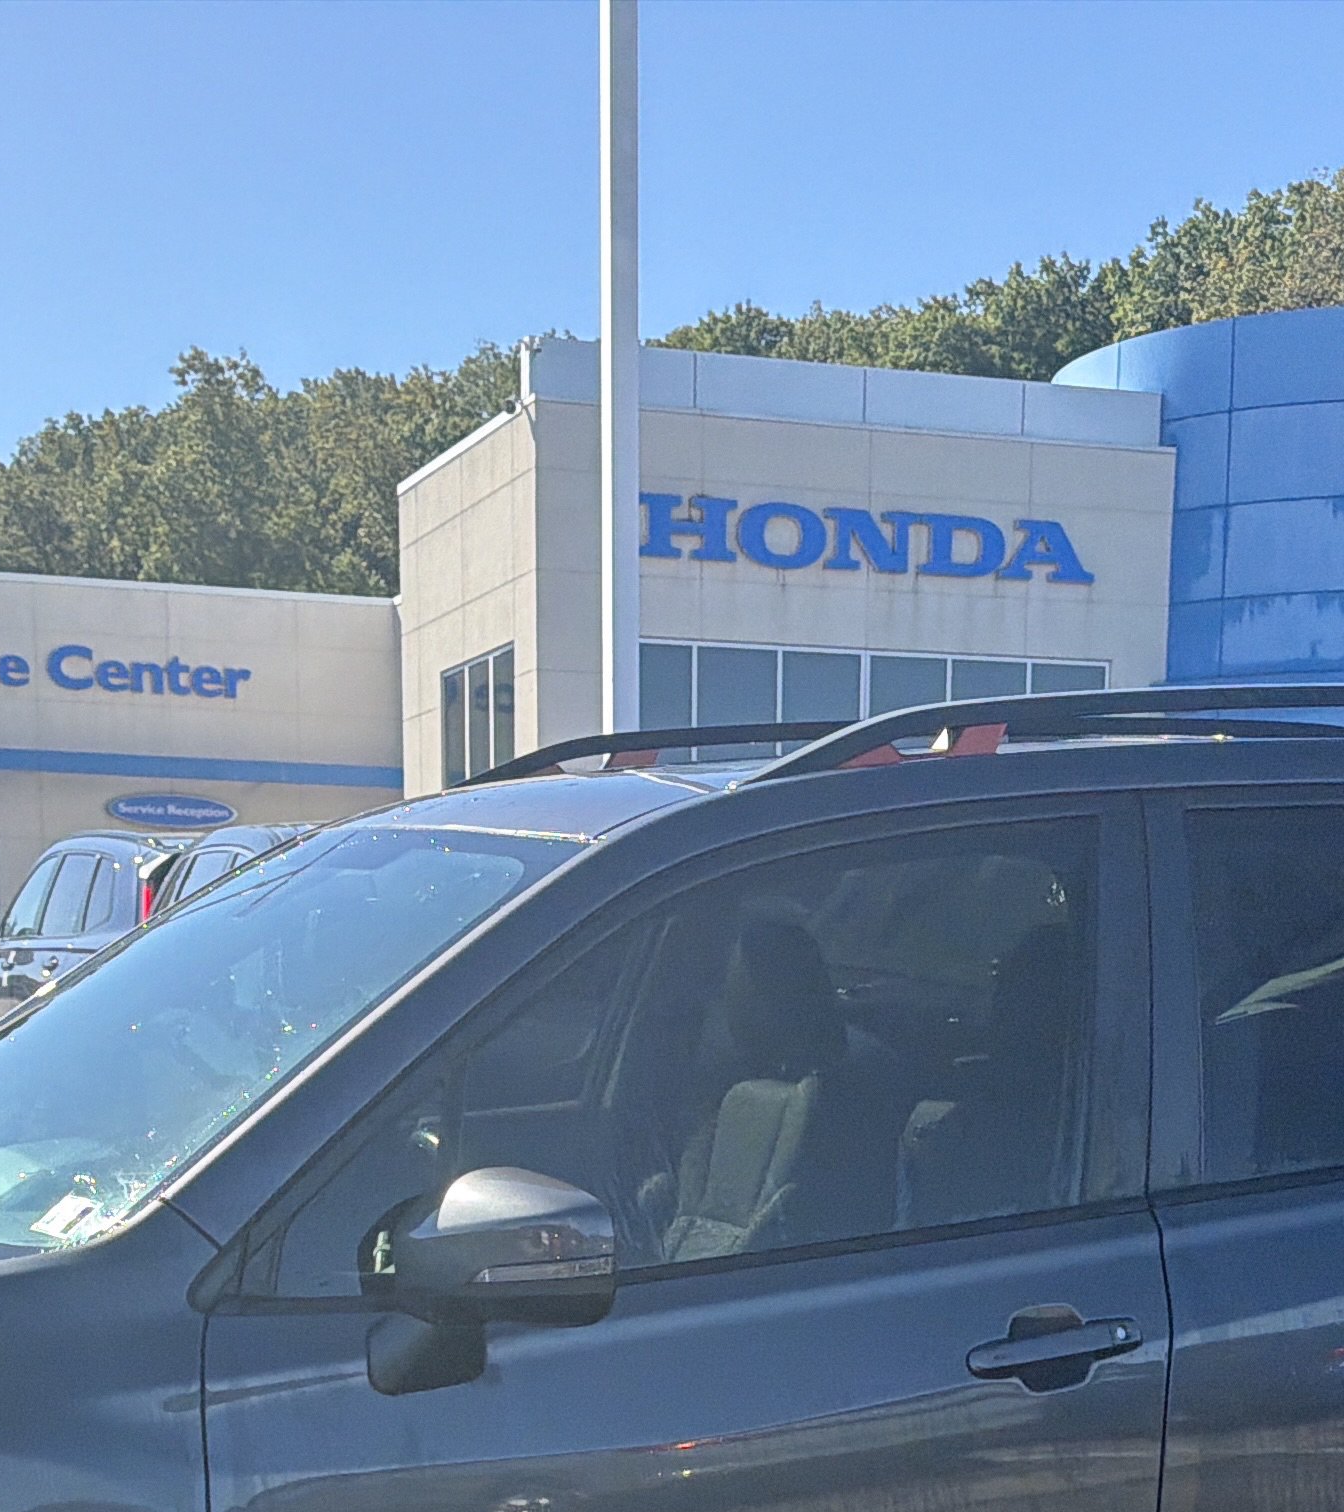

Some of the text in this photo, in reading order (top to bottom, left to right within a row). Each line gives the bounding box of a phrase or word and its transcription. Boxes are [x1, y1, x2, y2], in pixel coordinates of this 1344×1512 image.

[638, 493, 1095, 585] HONDA
[47, 645, 252, 699] Center
[117, 802, 230, 819] Service Reception
